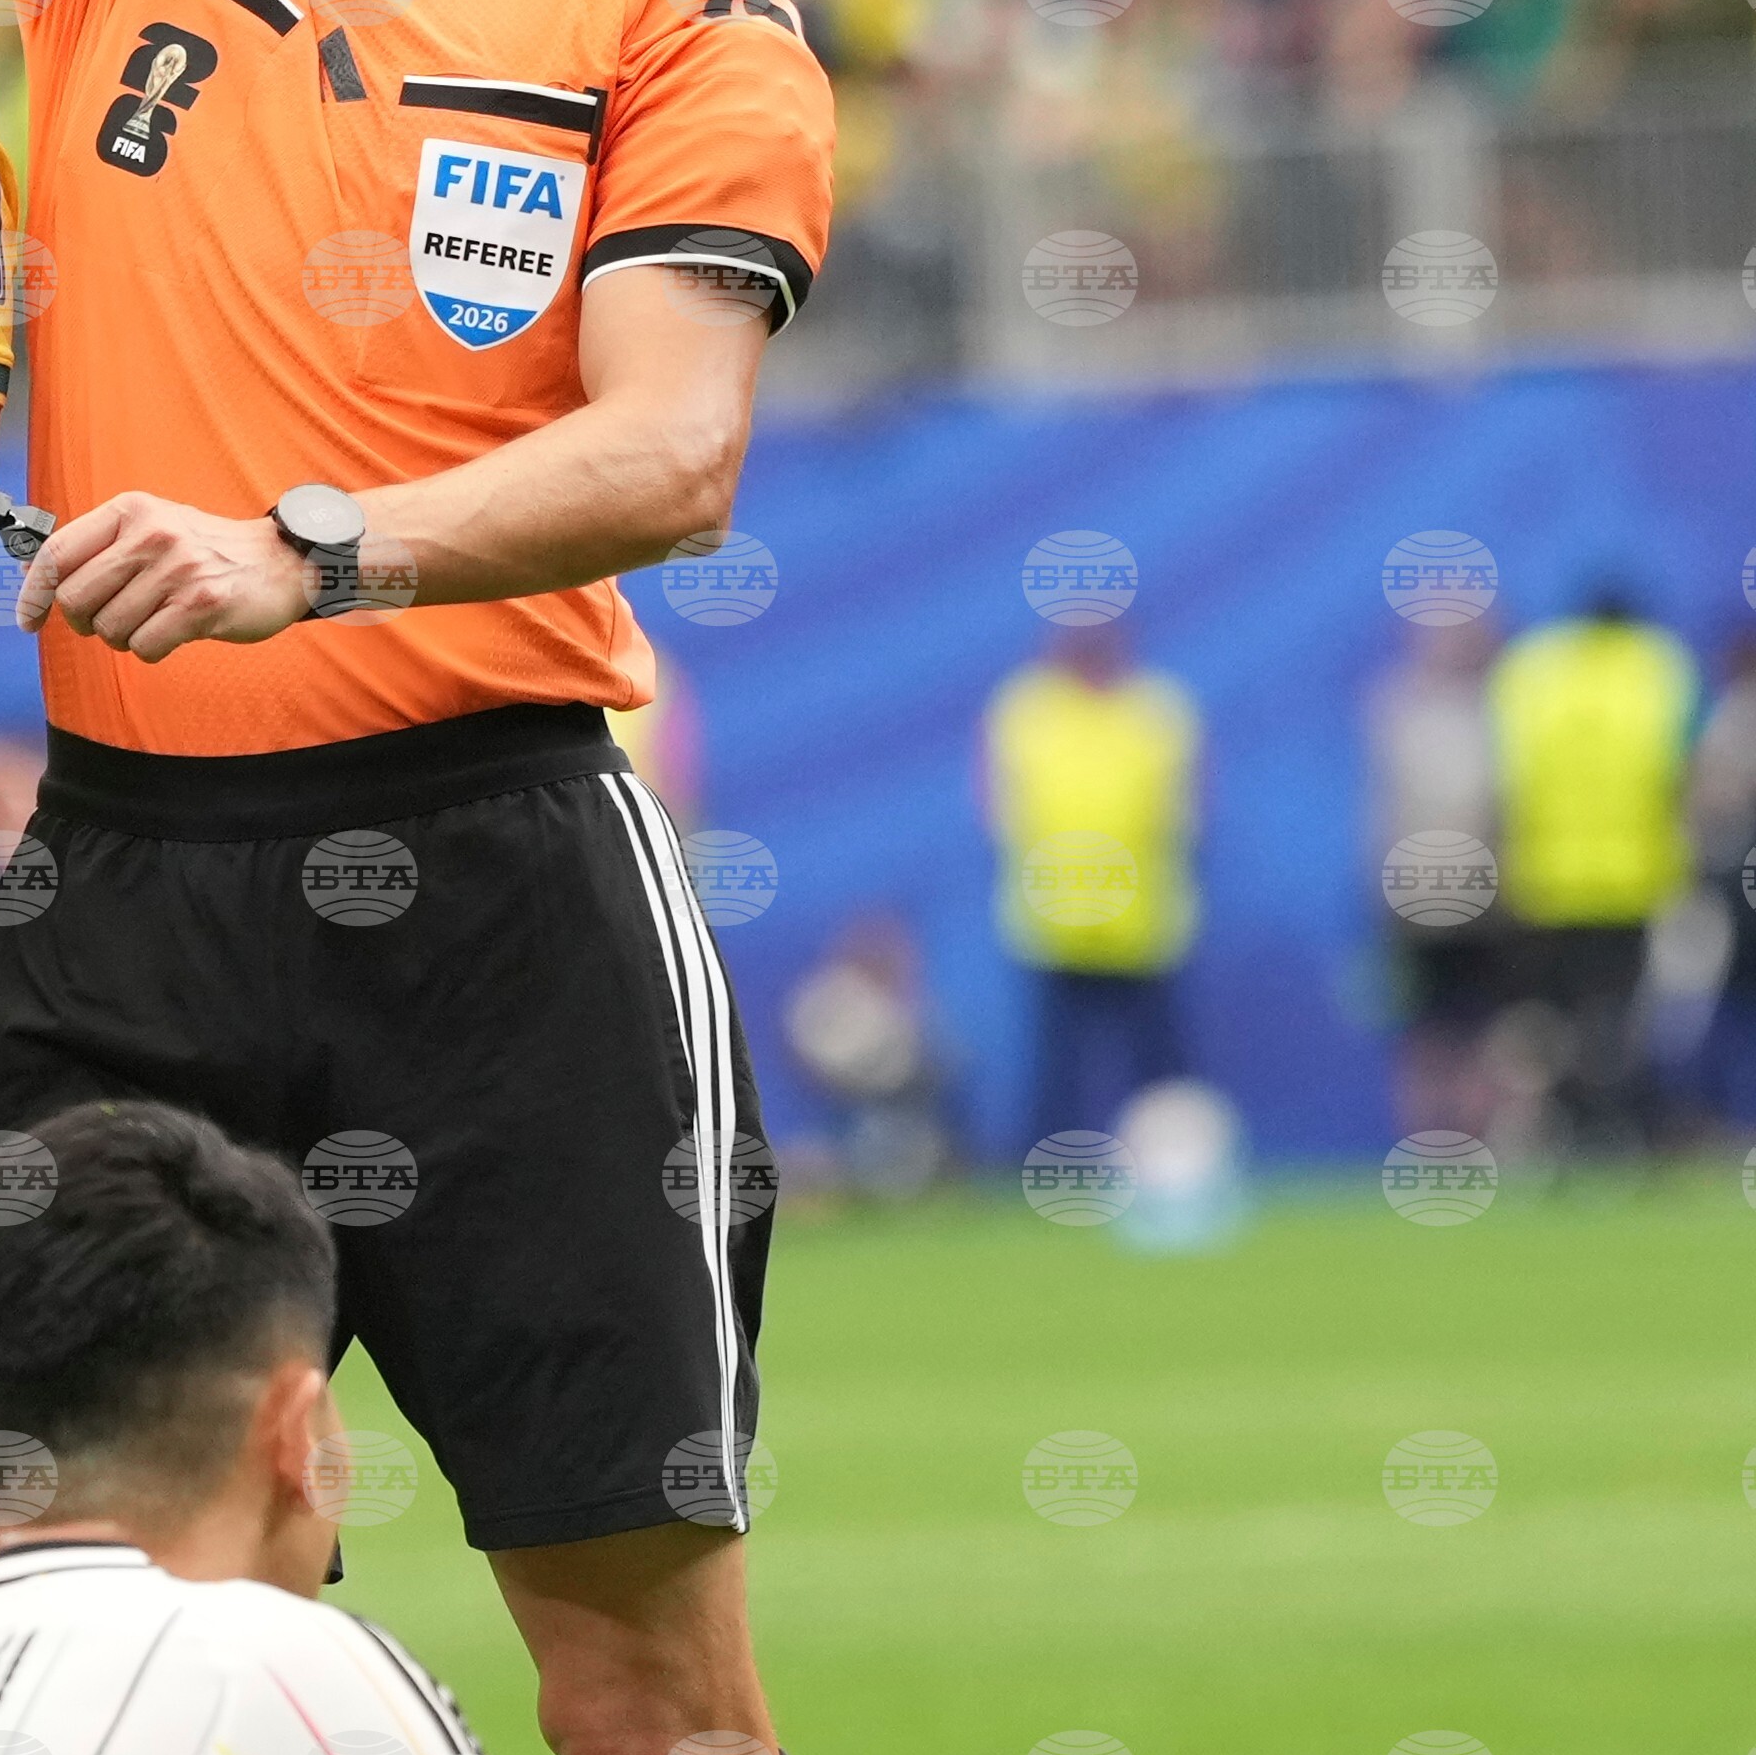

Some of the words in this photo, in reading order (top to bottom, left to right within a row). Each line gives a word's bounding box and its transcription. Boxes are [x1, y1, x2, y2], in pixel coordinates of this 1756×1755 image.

[111, 135, 147, 164] FIFA
[433, 153, 564, 220] FIFA
[423, 231, 555, 277] REFEREE
[447, 303, 510, 334] 2026
